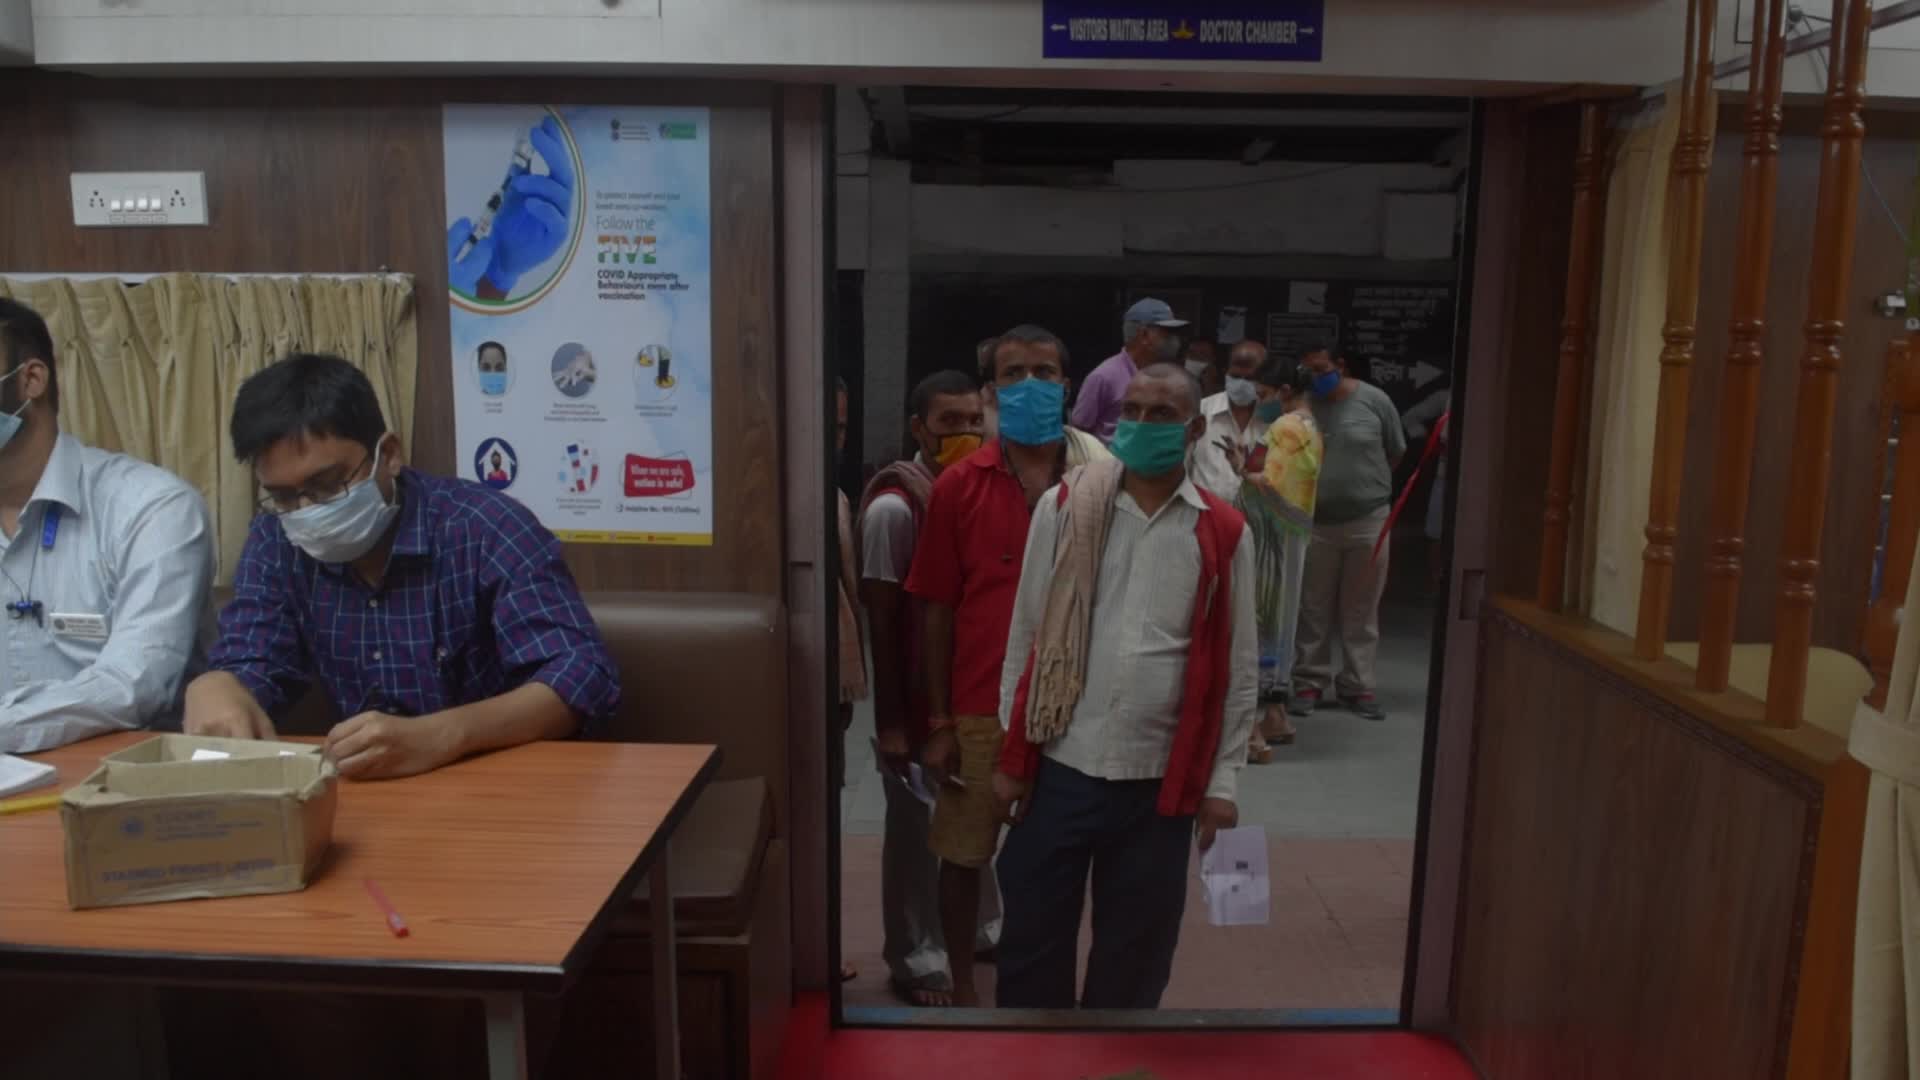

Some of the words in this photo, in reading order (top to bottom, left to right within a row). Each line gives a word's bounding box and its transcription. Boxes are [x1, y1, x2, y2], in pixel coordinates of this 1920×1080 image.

[1069, 18, 1108, 41] VISITORS
[1109, 19, 1146, 42] WAITING
[1147, 19, 1169, 42] AREA
[1199, 19, 1243, 43] DOCTOR
[1245, 20, 1297, 44] CHAMBER
[596, 214, 633, 231] Follow
[635, 214, 654, 231] the
[598, 235, 656, 264] FIVE
[597, 270, 625, 280] COVID
[627, 270, 679, 282] Appropriate
[597, 280, 644, 290] Behaviours
[598, 291, 645, 301] vaccination
